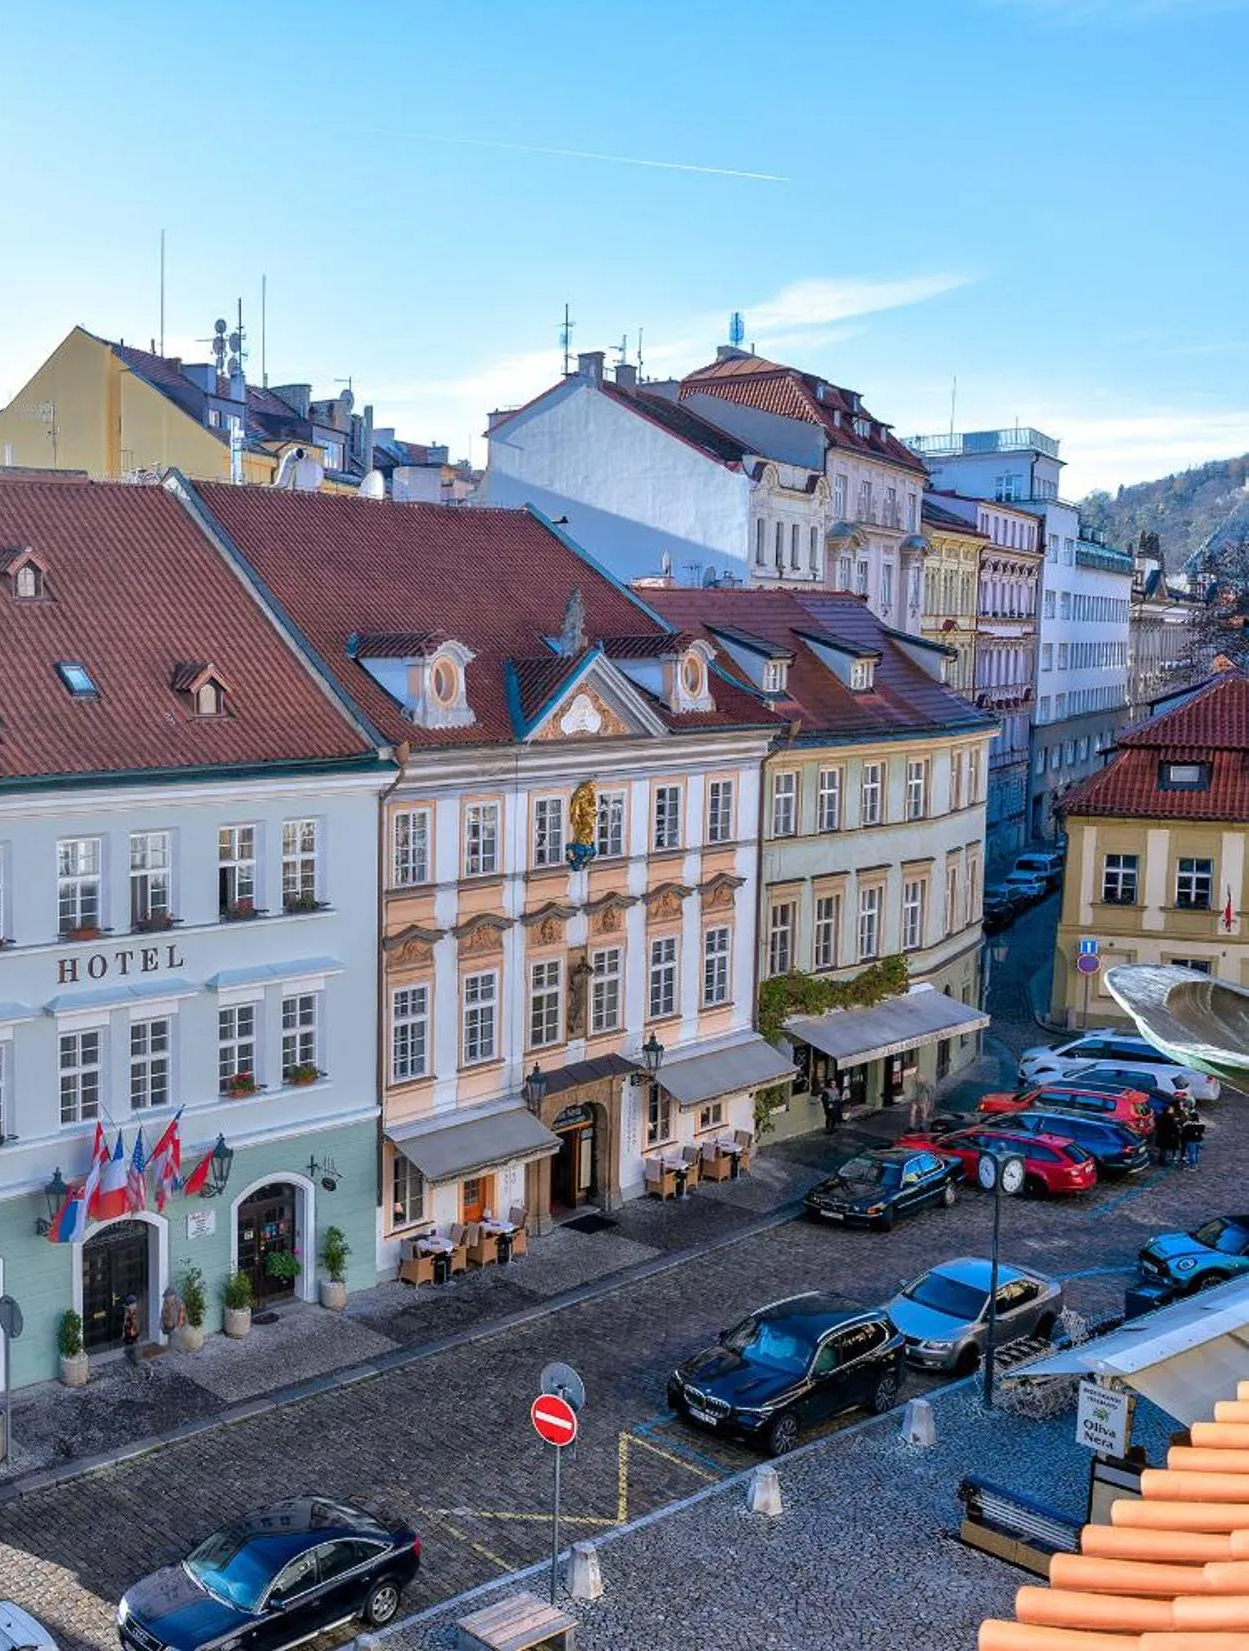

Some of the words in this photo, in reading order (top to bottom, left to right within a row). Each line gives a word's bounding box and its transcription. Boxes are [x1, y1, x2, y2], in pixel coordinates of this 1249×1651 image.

[57, 944, 184, 984] HOTEL
[1083, 1419, 1116, 1438] Oliva
[1084, 1431, 1114, 1450] Nera
